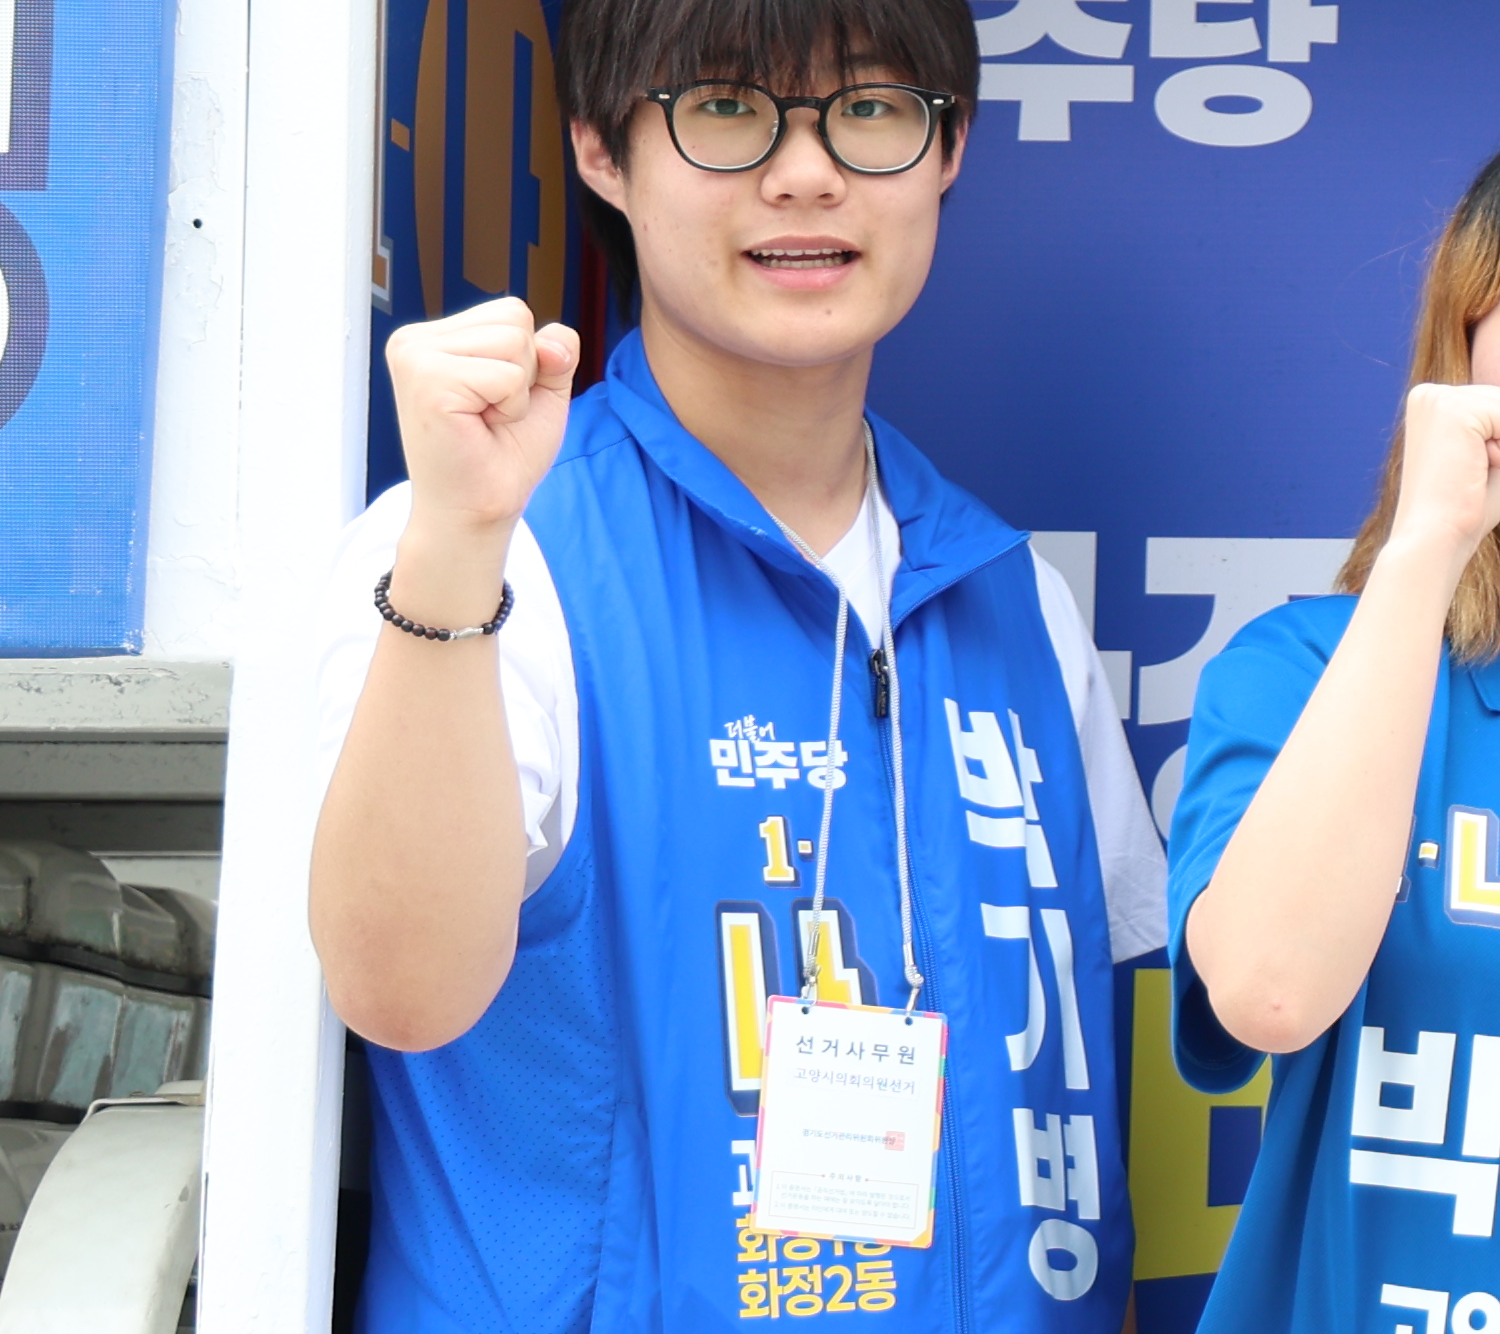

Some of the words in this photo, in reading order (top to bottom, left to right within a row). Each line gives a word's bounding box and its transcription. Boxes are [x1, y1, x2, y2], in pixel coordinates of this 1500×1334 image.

[724, 714, 777, 744] 더불어
[709, 738, 849, 790] 민주당
[944, 697, 1101, 1302] 박기병
[796, 1034, 916, 1065] 선거사무원
[793, 1067, 916, 1095] 고양시의회의원선거
[738, 1259, 898, 1319] 화정2동
